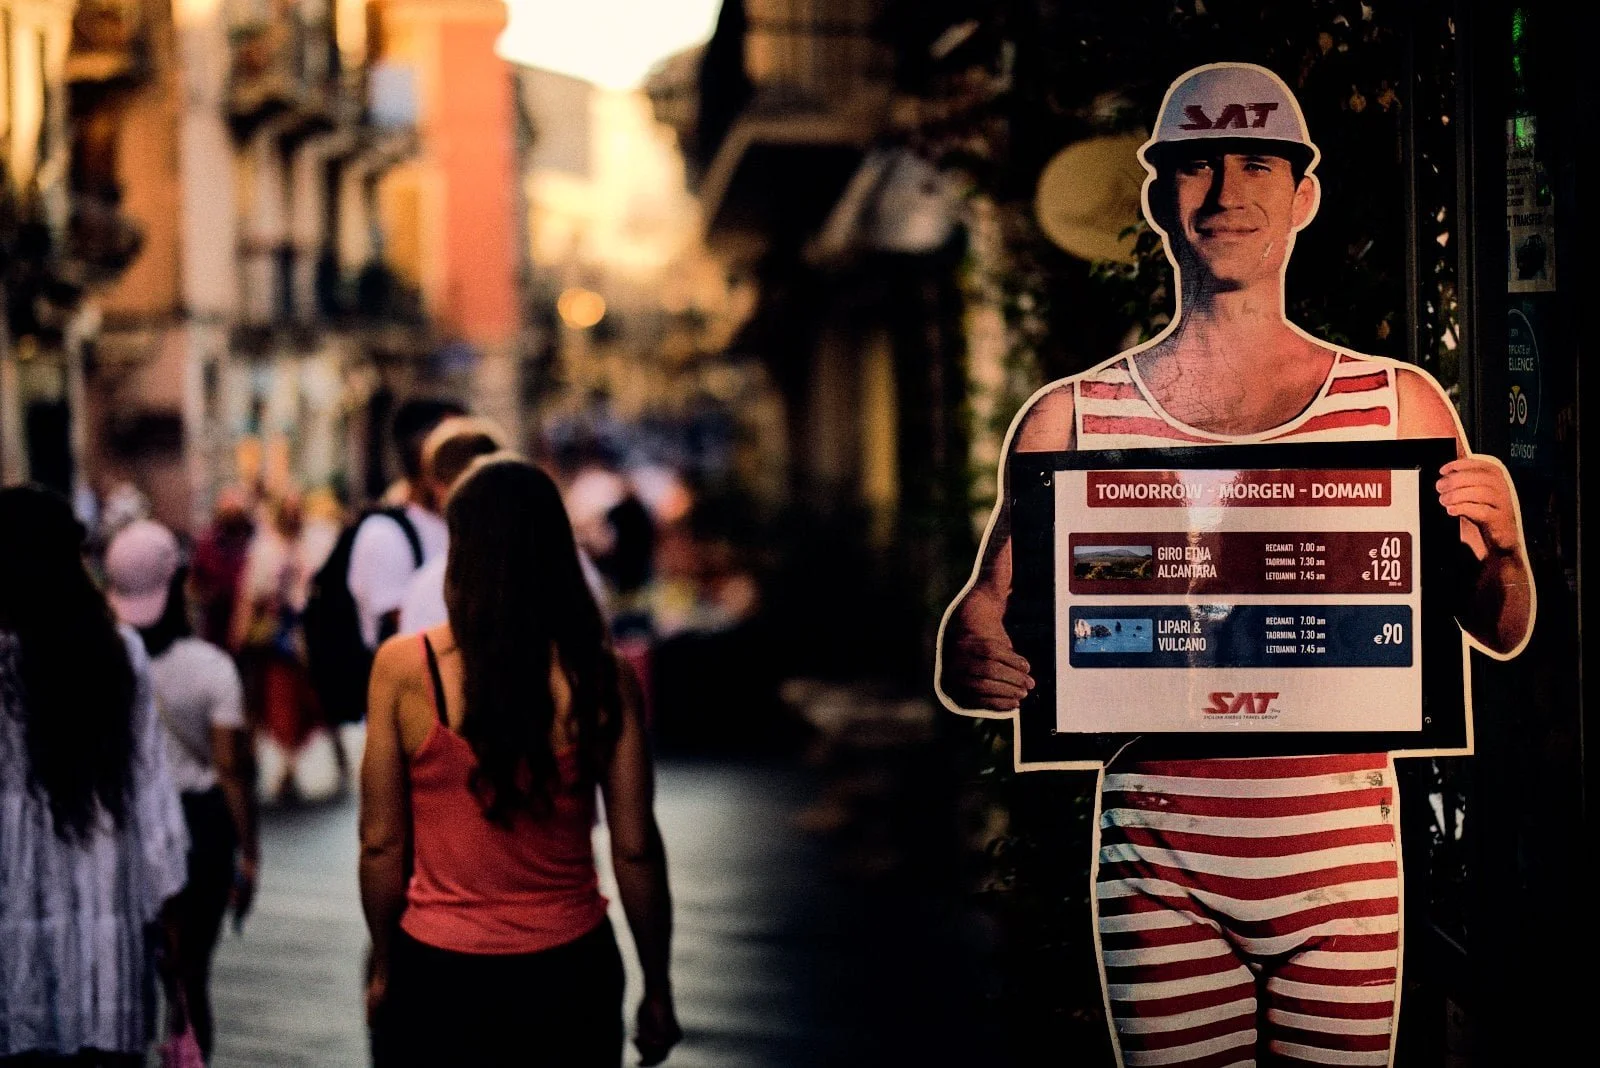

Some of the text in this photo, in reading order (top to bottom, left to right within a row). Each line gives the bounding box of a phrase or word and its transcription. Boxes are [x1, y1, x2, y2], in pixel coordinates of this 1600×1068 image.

[1178, 102, 1279, 130] SAT
[1096, 483, 1202, 499] TOMORROW
[1219, 483, 1295, 499] MORGEN
[1311, 483, 1383, 499] DOMANI
[1157, 546, 1212, 561] GIRO ETNA
[1265, 543, 1294, 552] RECANATI
[1300, 542, 1315, 552] 7.00
[1265, 557, 1296, 566] TAORMINA
[1300, 556, 1315, 566] 7.30
[1157, 564, 1218, 578] ALCANTARA
[1300, 571, 1315, 581] 7.45
[1158, 620, 1202, 634] LIPARI &
[1265, 616, 1295, 625] RECANATI
[1300, 615, 1316, 625] 7.00
[1266, 631, 1297, 640] TAORMINA
[1300, 630, 1316, 640] 7.30
[1158, 637, 1207, 651] VULCANO
[1300, 644, 1316, 654] 7.45
[1201, 692, 1280, 714] SAT
